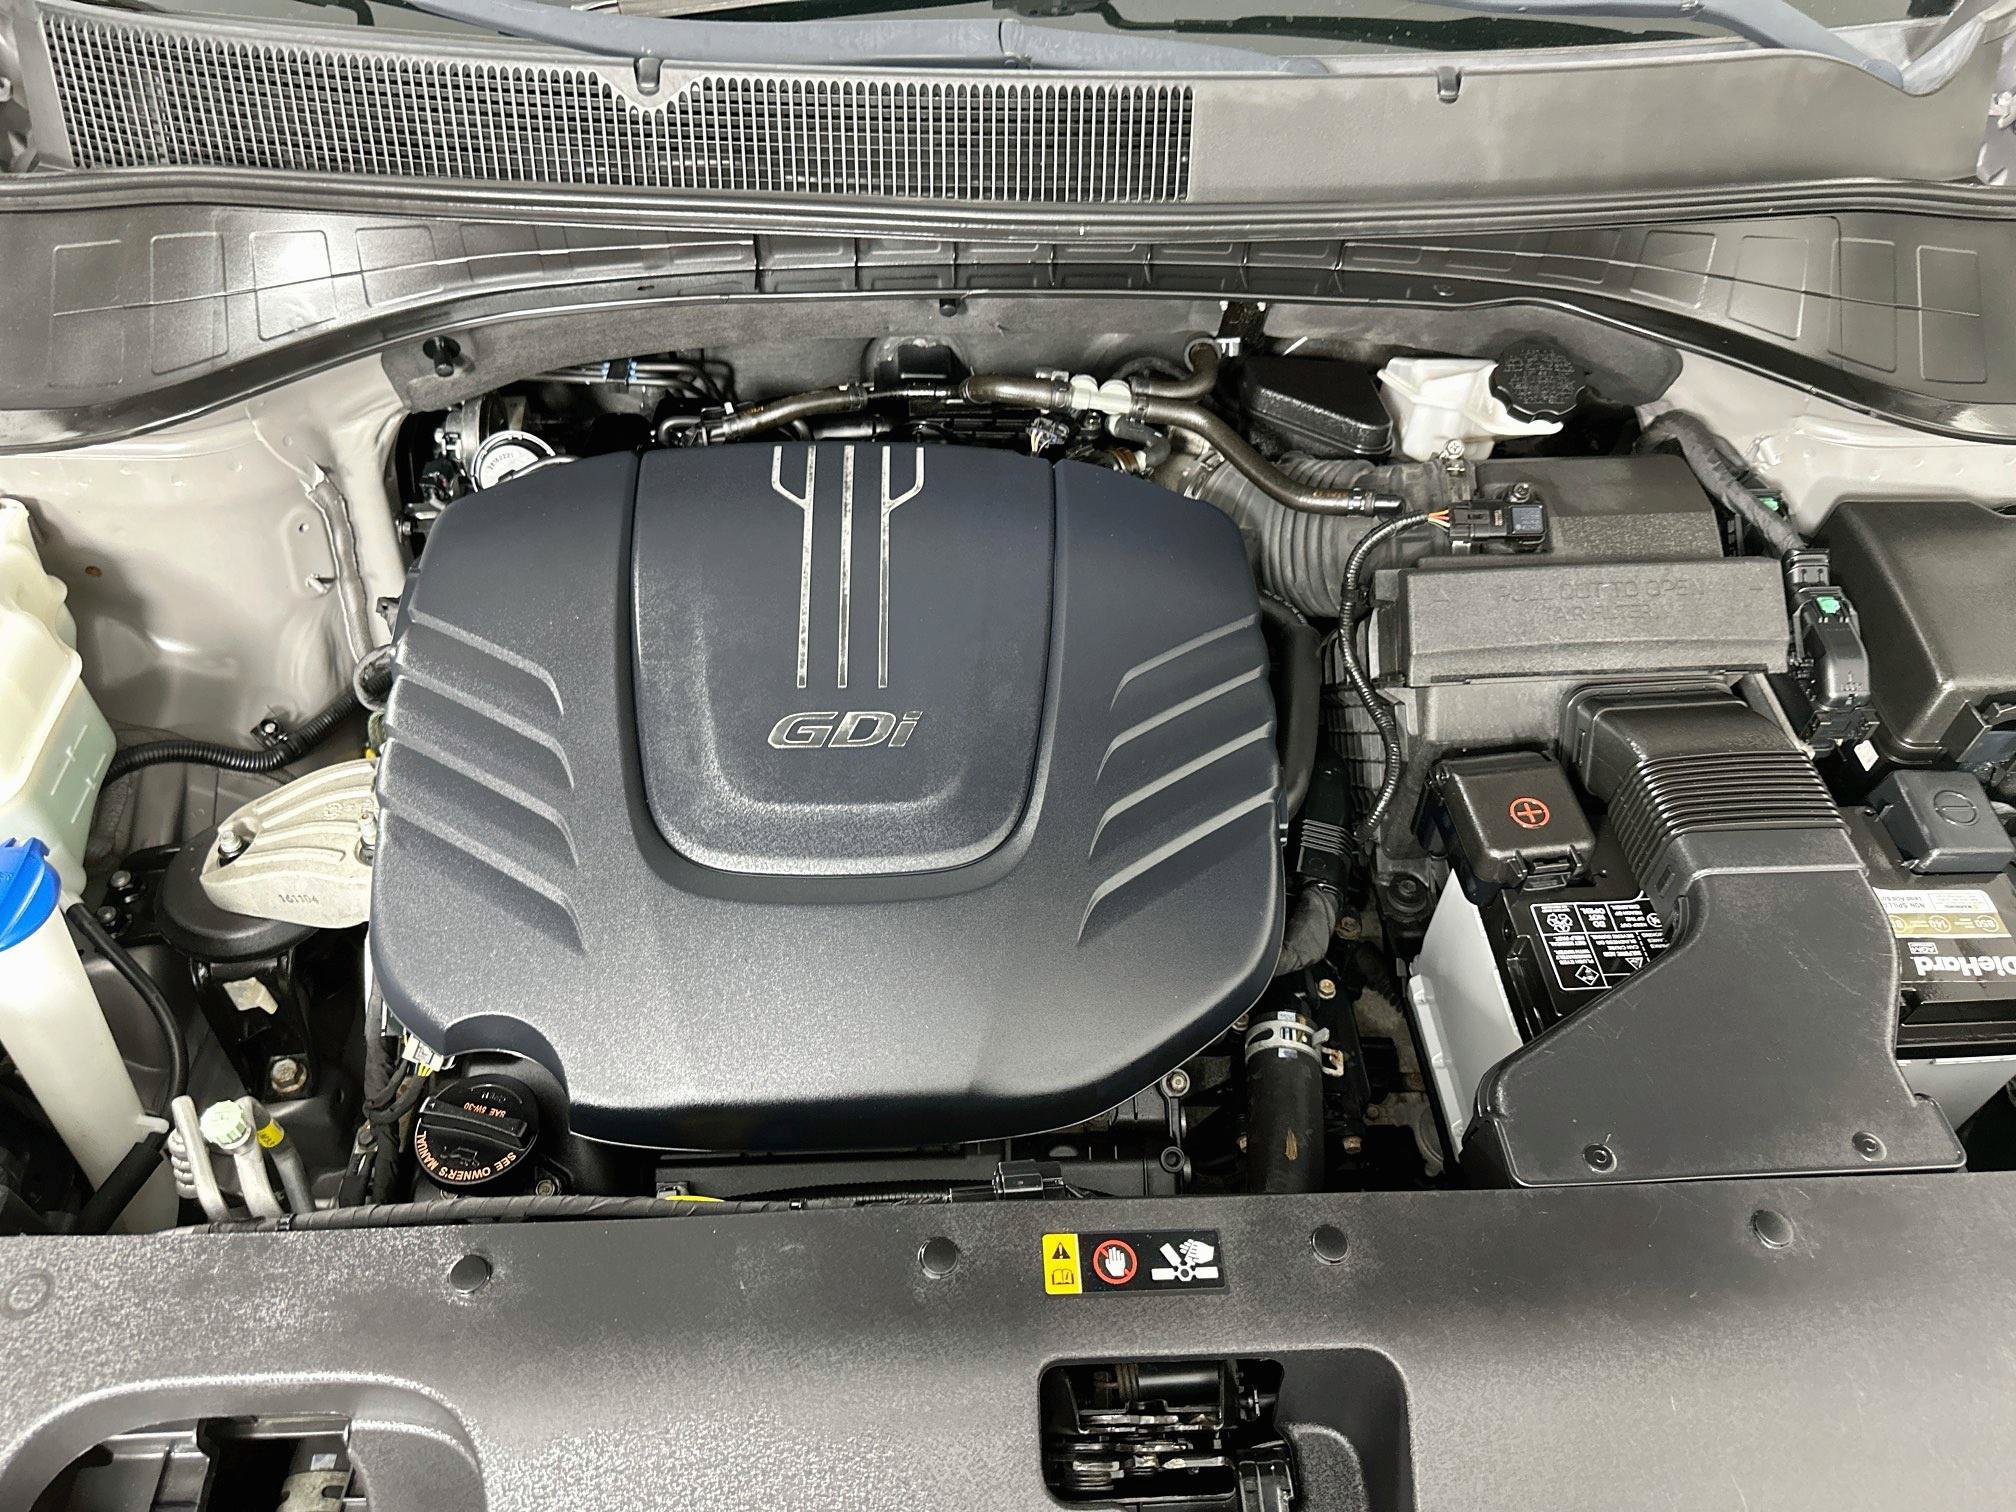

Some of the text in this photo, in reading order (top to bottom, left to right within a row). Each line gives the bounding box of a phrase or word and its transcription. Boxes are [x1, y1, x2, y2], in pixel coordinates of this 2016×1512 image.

[767, 710, 923, 749] GDi
[463, 1102, 506, 1118] SAE 5W-30
[416, 1130, 517, 1181] SEE OWNER'S MANUAL
